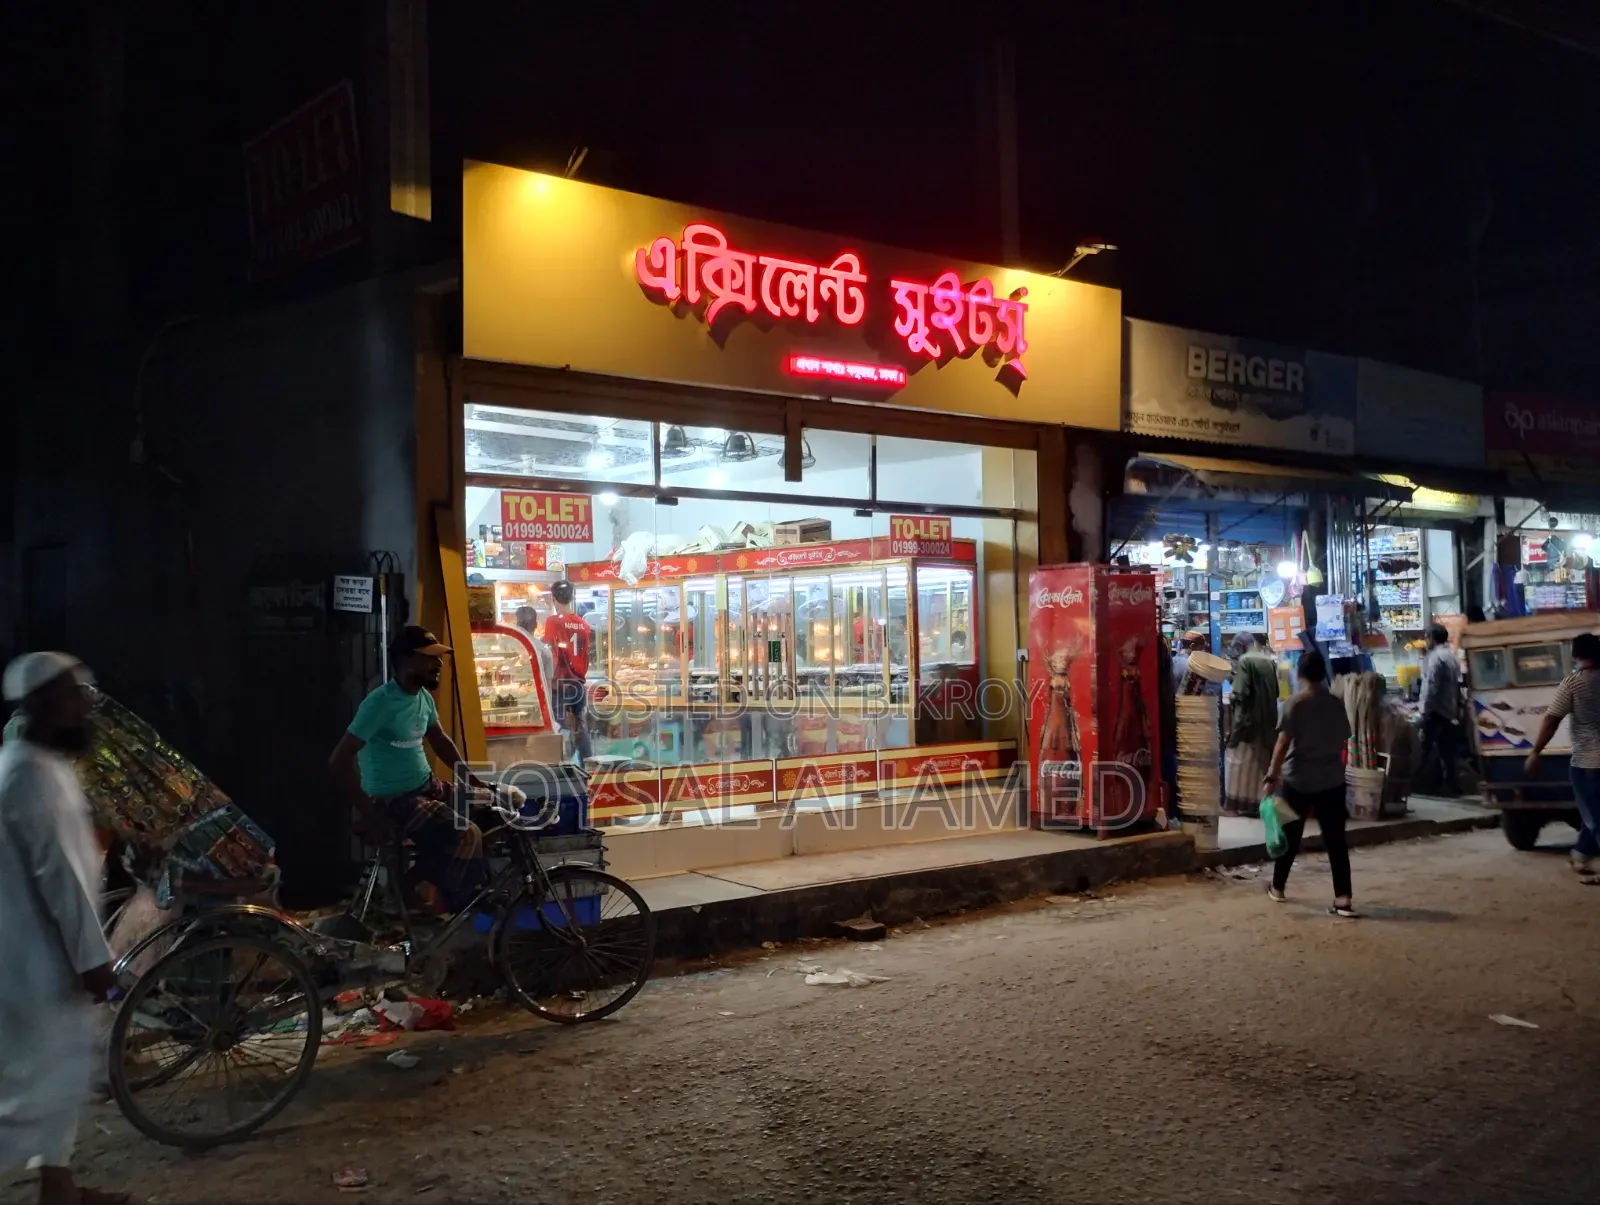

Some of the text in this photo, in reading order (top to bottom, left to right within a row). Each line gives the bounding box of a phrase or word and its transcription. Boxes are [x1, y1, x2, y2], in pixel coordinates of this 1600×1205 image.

[1188, 345, 1305, 393] BERGER
[504, 495, 589, 522] TO-LET
[505, 522, 590, 540] 01999-300024
[892, 518, 950, 540] TO-LET
[892, 540, 950, 555] 01999-300024
[570, 632, 578, 657] 1
